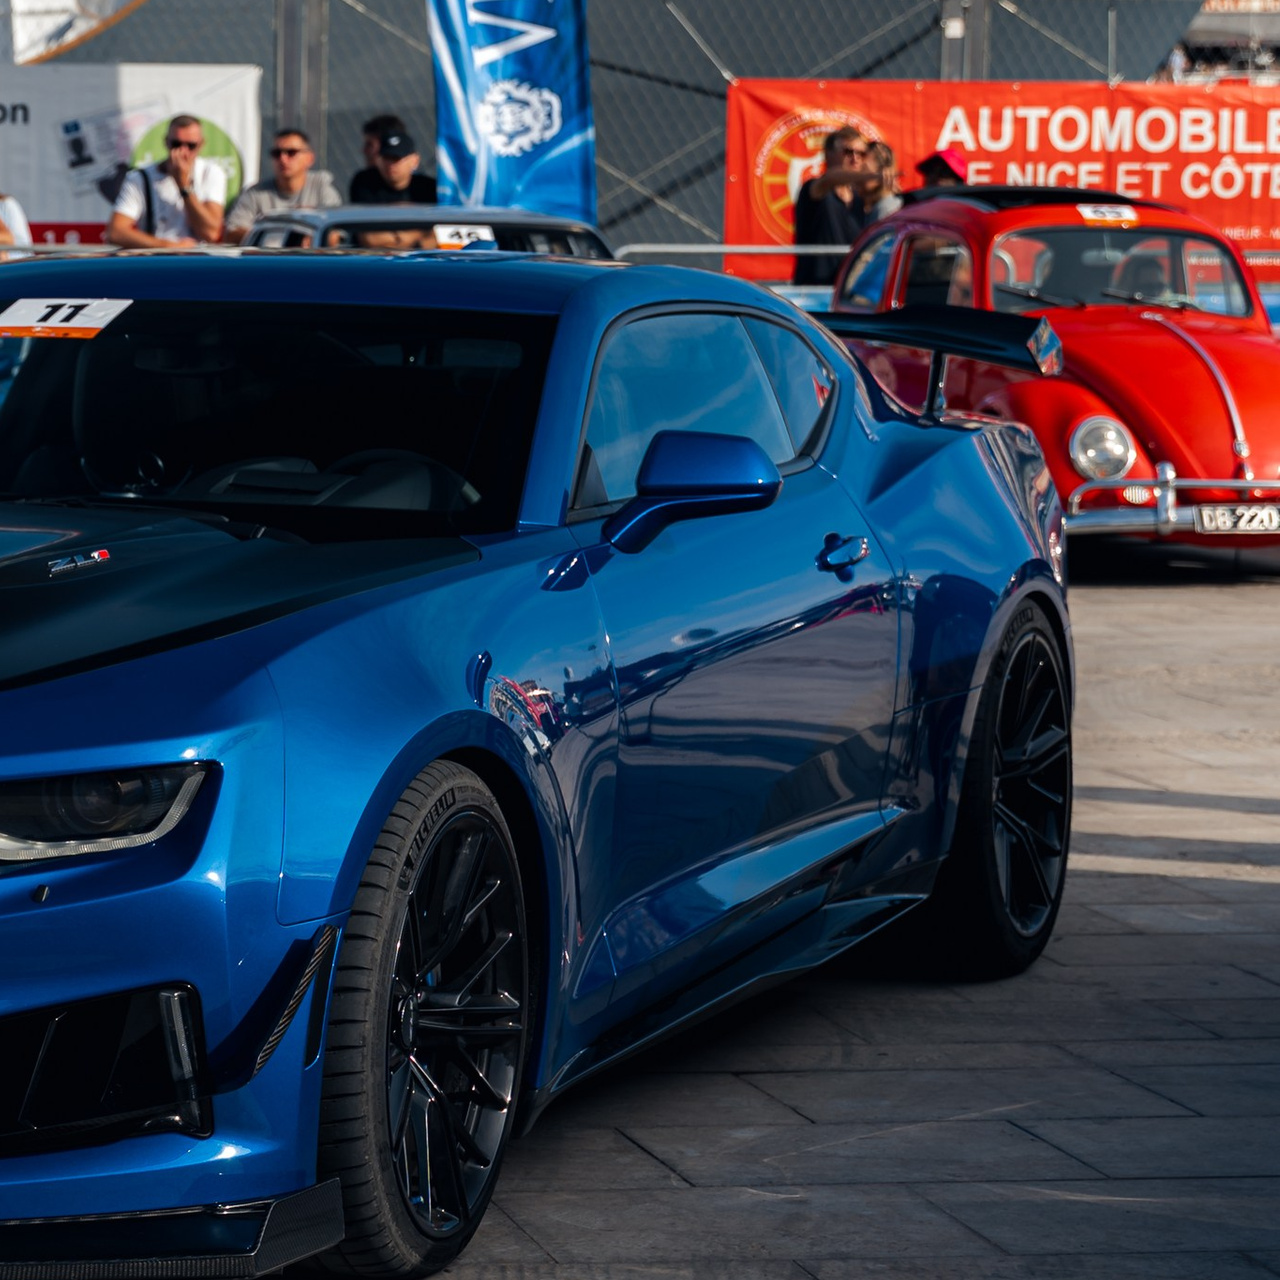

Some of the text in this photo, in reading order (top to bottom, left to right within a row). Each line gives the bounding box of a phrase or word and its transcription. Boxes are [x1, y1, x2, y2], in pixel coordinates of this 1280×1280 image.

[1116, 162, 1171, 198] ET
[36, 303, 90, 323] 11
[408, 788, 457, 863] MICHELIN
